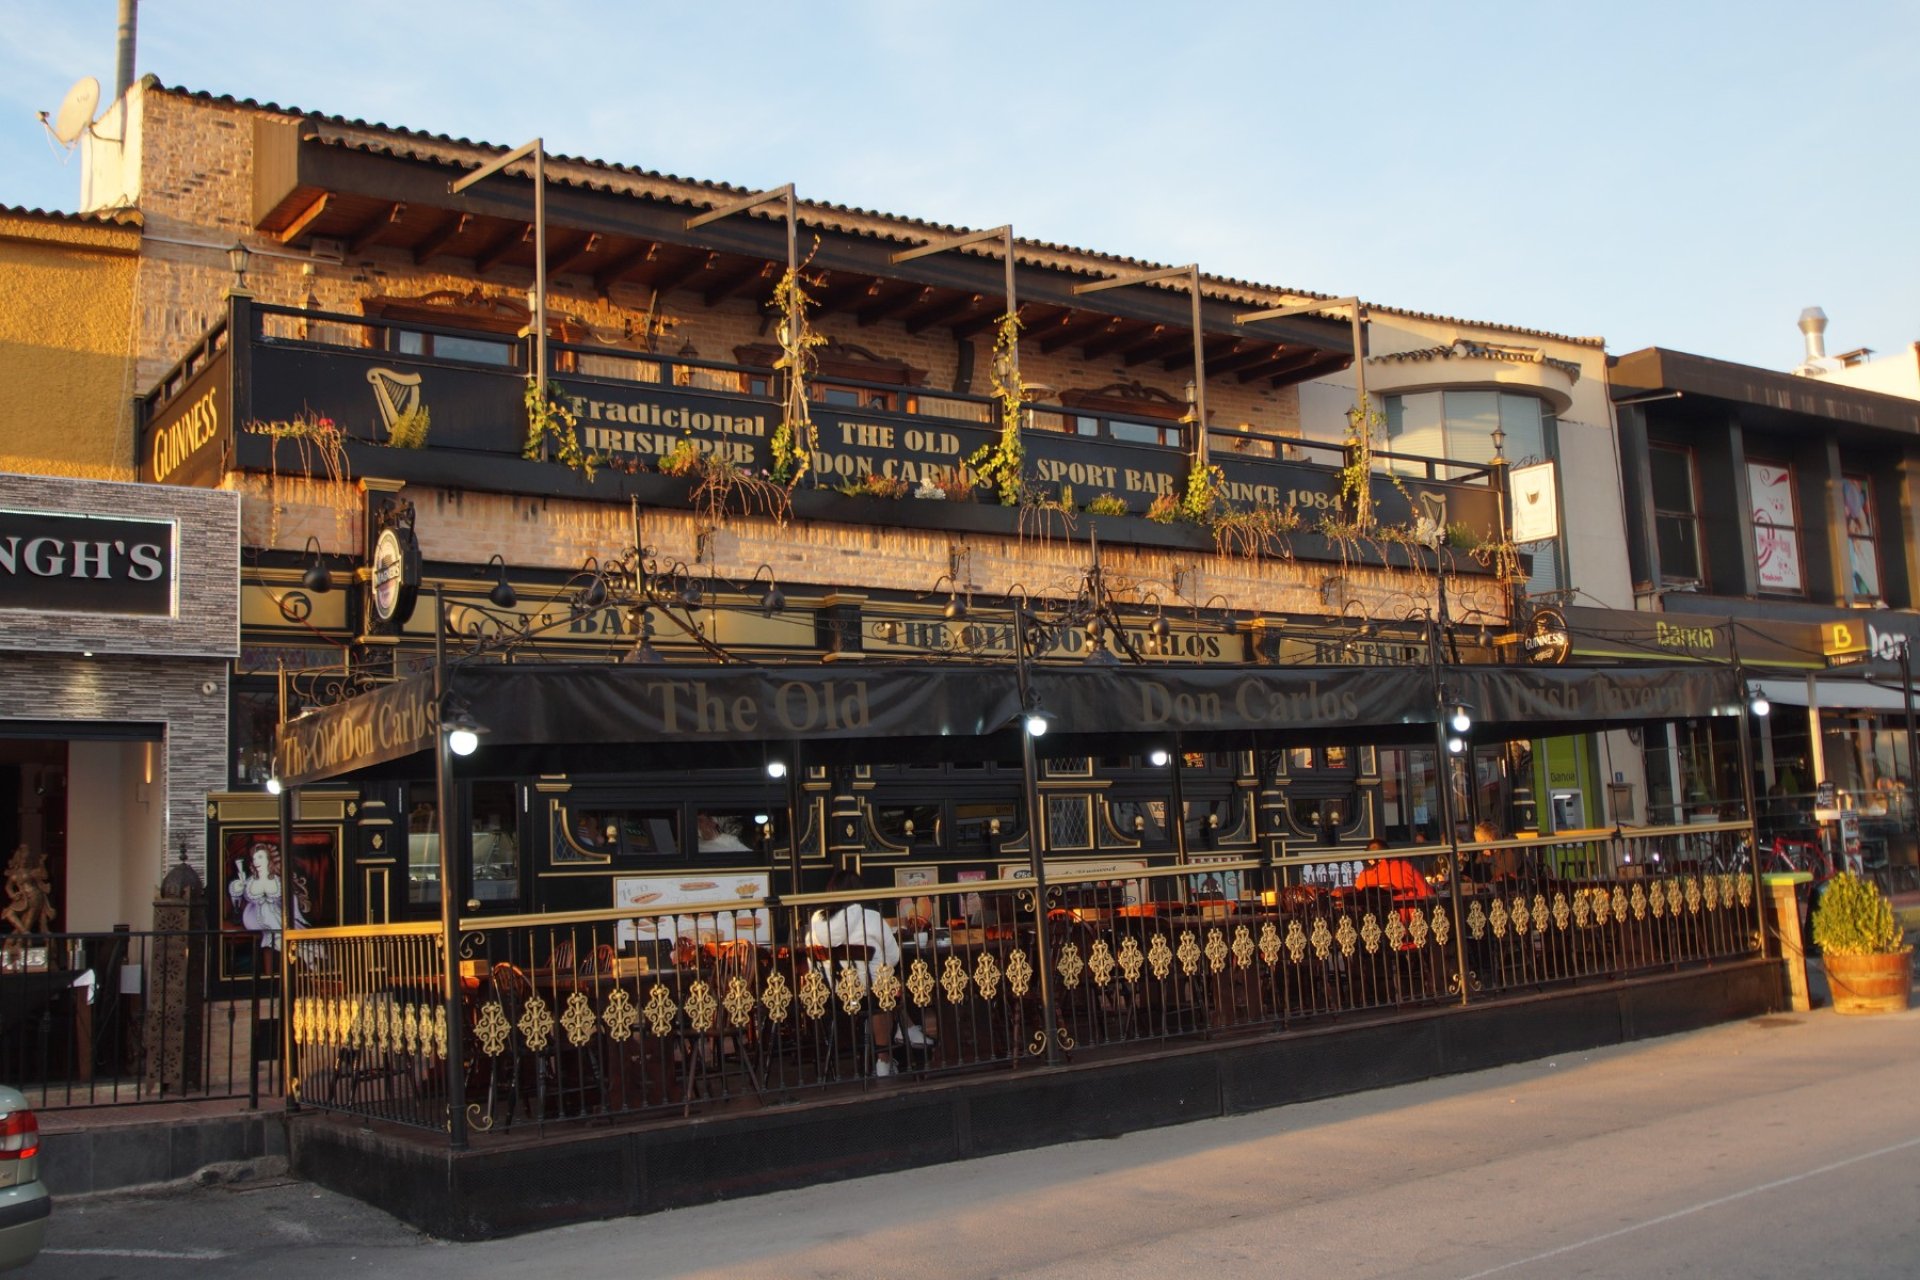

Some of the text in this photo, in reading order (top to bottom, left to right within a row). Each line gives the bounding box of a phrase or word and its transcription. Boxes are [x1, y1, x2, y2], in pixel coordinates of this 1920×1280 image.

[571, 395, 766, 437] Tradicional
[153, 386, 218, 483] GUINNESS
[584, 427, 756, 465] IRISH PUB
[837, 421, 961, 456] THE OLD
[813, 451, 874, 480] DON
[1036, 457, 1175, 496] SPORT BAR
[1218, 480, 1344, 513] SINCE 1984
[568, 603, 657, 637] BAR
[880, 620, 949, 650] THE
[1655, 620, 1716, 649] Bankia
[1524, 632, 1566, 651] GUINNESS
[647, 674, 1683, 734] The Old Don Carlos Irish Tavern
[283, 692, 437, 778] The Old Don Carlos
